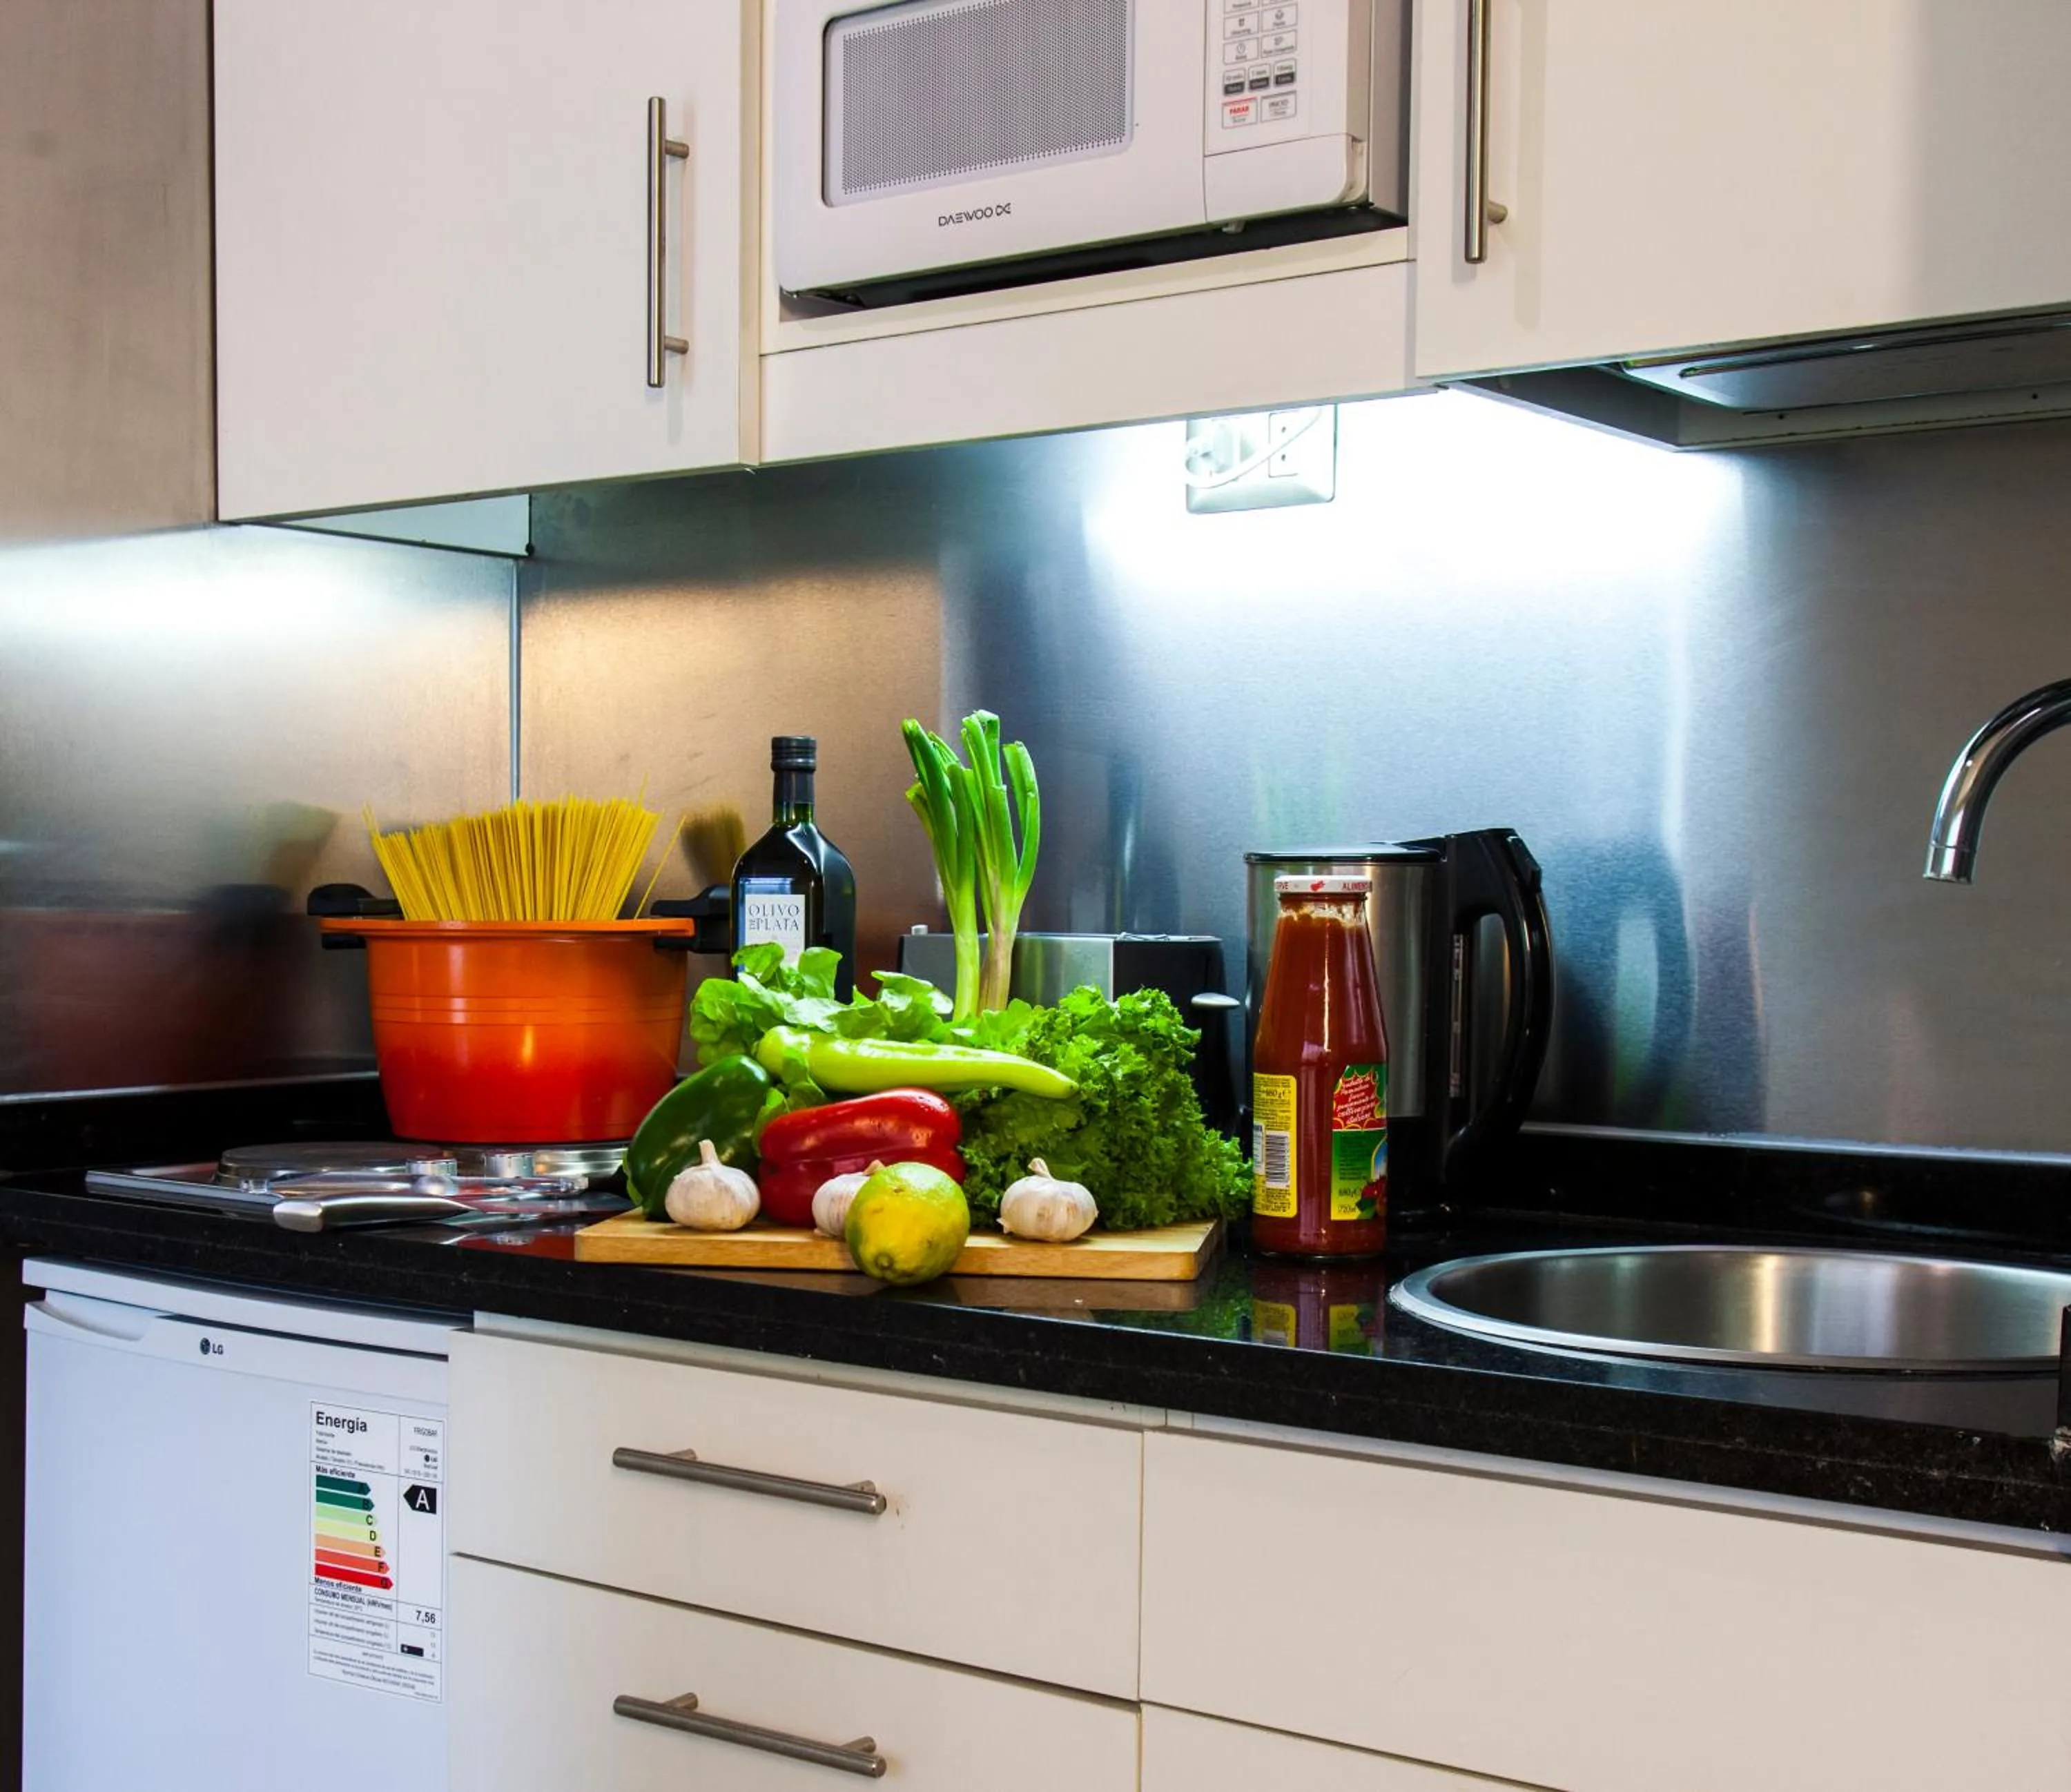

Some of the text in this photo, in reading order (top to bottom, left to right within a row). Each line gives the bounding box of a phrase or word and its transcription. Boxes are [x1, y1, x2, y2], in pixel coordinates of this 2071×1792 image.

[938, 207, 993, 226] DAEWOO
[748, 903, 800, 917] OLIVO
[756, 918, 799, 931] PLATA
[416, 1489, 430, 1510] A
[365, 1514, 373, 1526] C
[369, 1530, 376, 1541] D
[374, 1546, 381, 1557] E
